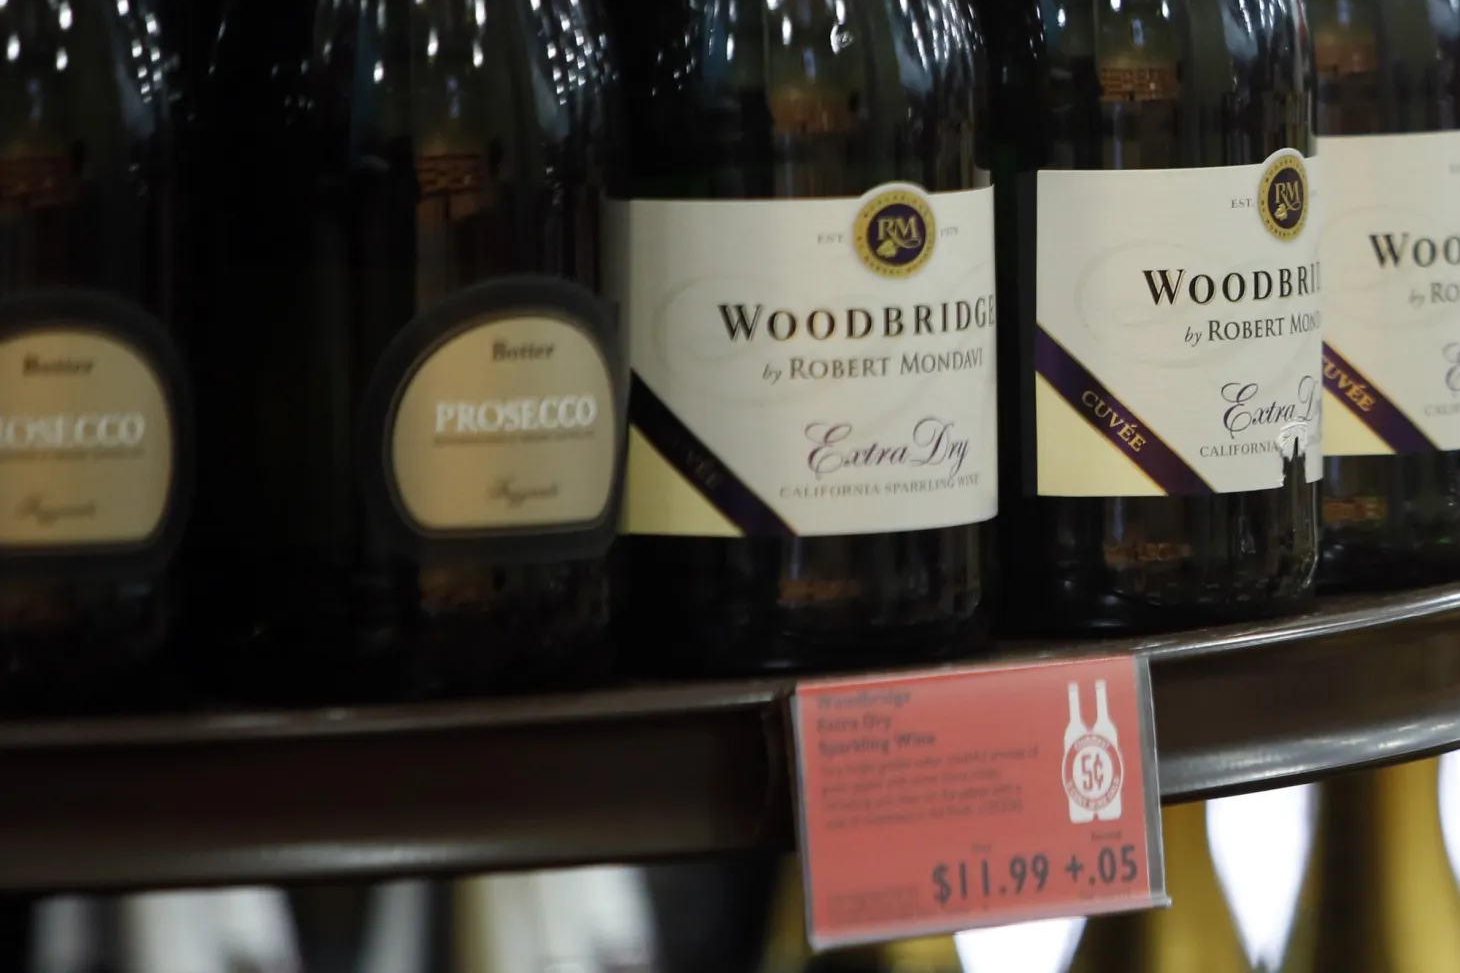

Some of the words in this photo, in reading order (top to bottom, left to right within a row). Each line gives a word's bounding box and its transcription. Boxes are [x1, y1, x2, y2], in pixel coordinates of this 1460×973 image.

[1274, 180, 1302, 211] RM
[877, 214, 923, 249] RM
[717, 294, 997, 343] WOODBRIDGE
[1184, 326, 1203, 348] by
[1207, 317, 1286, 342] ROBERT
[762, 362, 783, 386] by
[789, 356, 893, 381] ROBERT
[900, 346, 984, 376] MONDAVI
[433, 392, 598, 434] PROSECCO
[1081, 389, 1148, 454] CUVÉE
[1220, 382, 1296, 440] Extra
[803, 422, 909, 481] Extra
[909, 416, 970, 478] Dry
[1199, 441, 1279, 458] CALIFORNIA
[778, 483, 880, 500] CALIFORNIA
[884, 478, 955, 495] SPARKLING
[1081, 752, 1104, 791] 5¢
[932, 852, 1050, 906] $11.99
